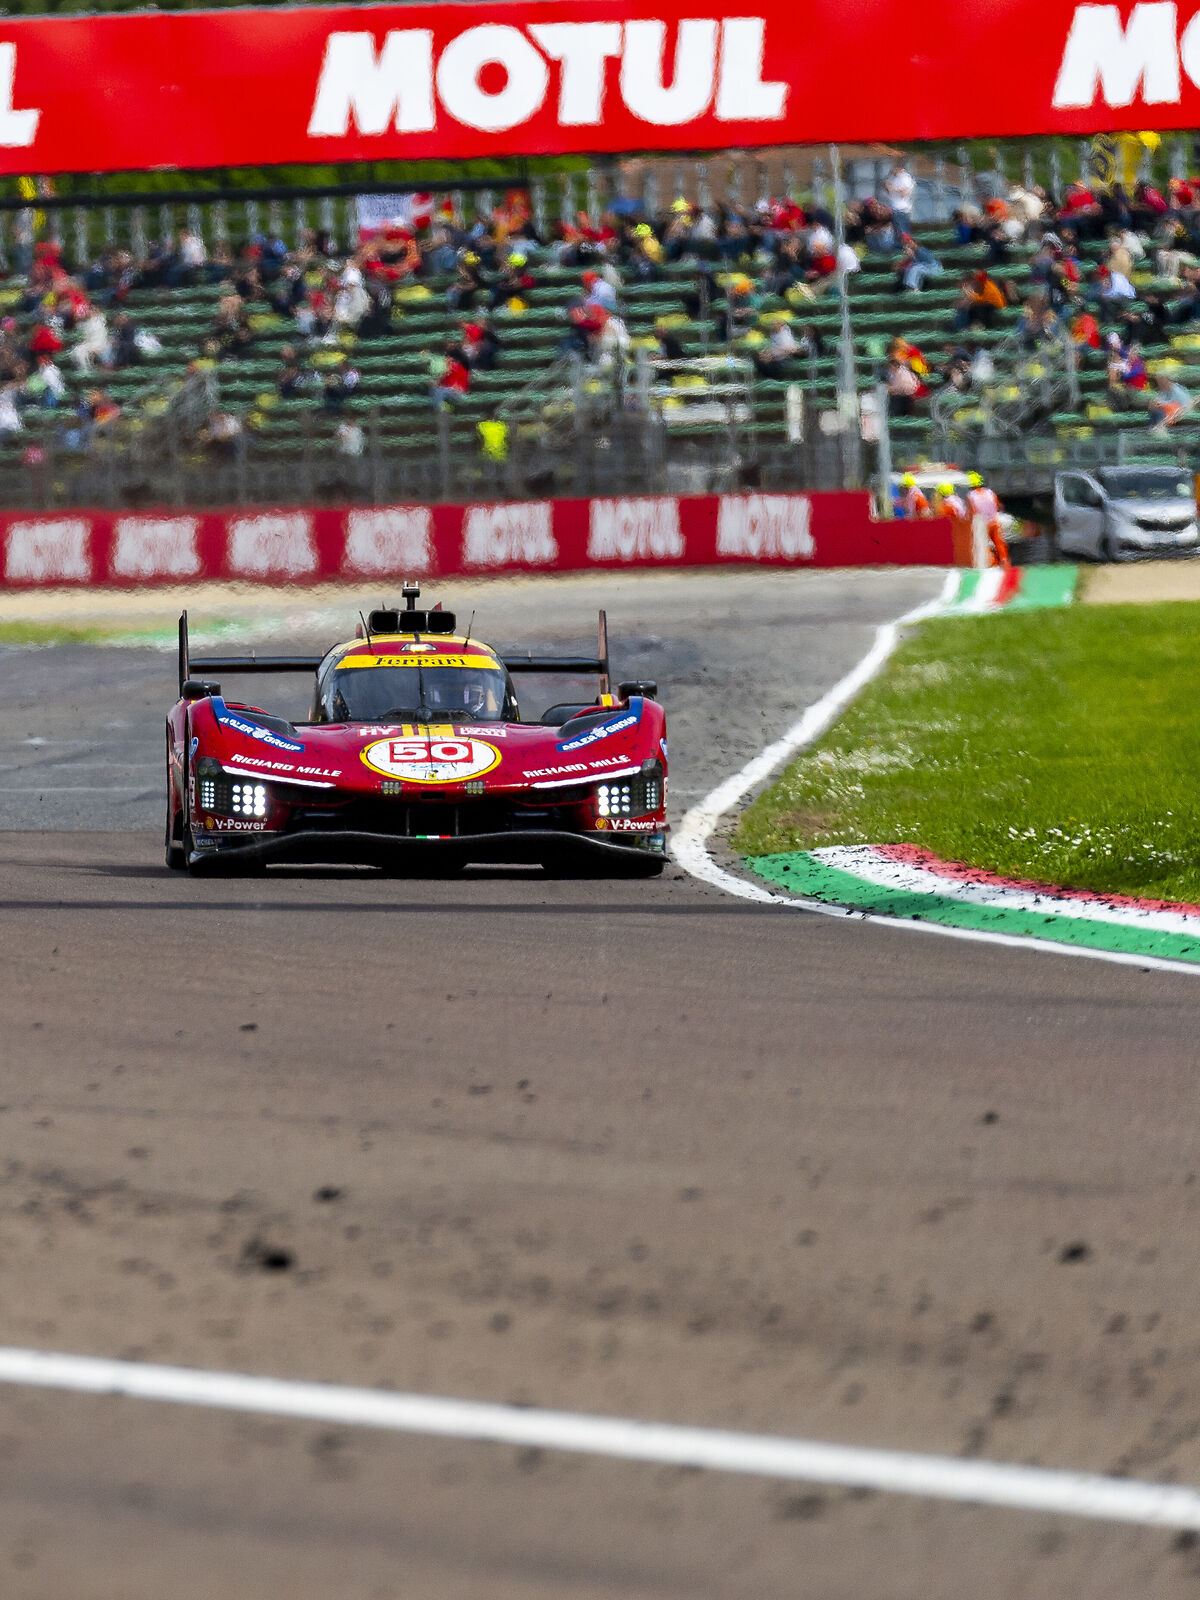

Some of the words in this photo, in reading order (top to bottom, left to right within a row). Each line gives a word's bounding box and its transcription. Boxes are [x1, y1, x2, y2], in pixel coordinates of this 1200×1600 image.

[1052, 1, 1200, 108] M
[308, 16, 790, 138] MOTUL
[374, 655, 468, 666] Ferrari
[263, 735, 301, 751] GROUP
[562, 734, 598, 751] ADLER
[605, 715, 638, 734] GROUP
[393, 742, 469, 761] 50
[231, 753, 295, 771] RICHARD
[296, 765, 343, 777] MILLE
[522, 763, 588, 779] RICHARD
[589, 754, 631, 769] MILLE
[215, 818, 266, 830] V-Power
[611, 819, 655, 830] V-Power
